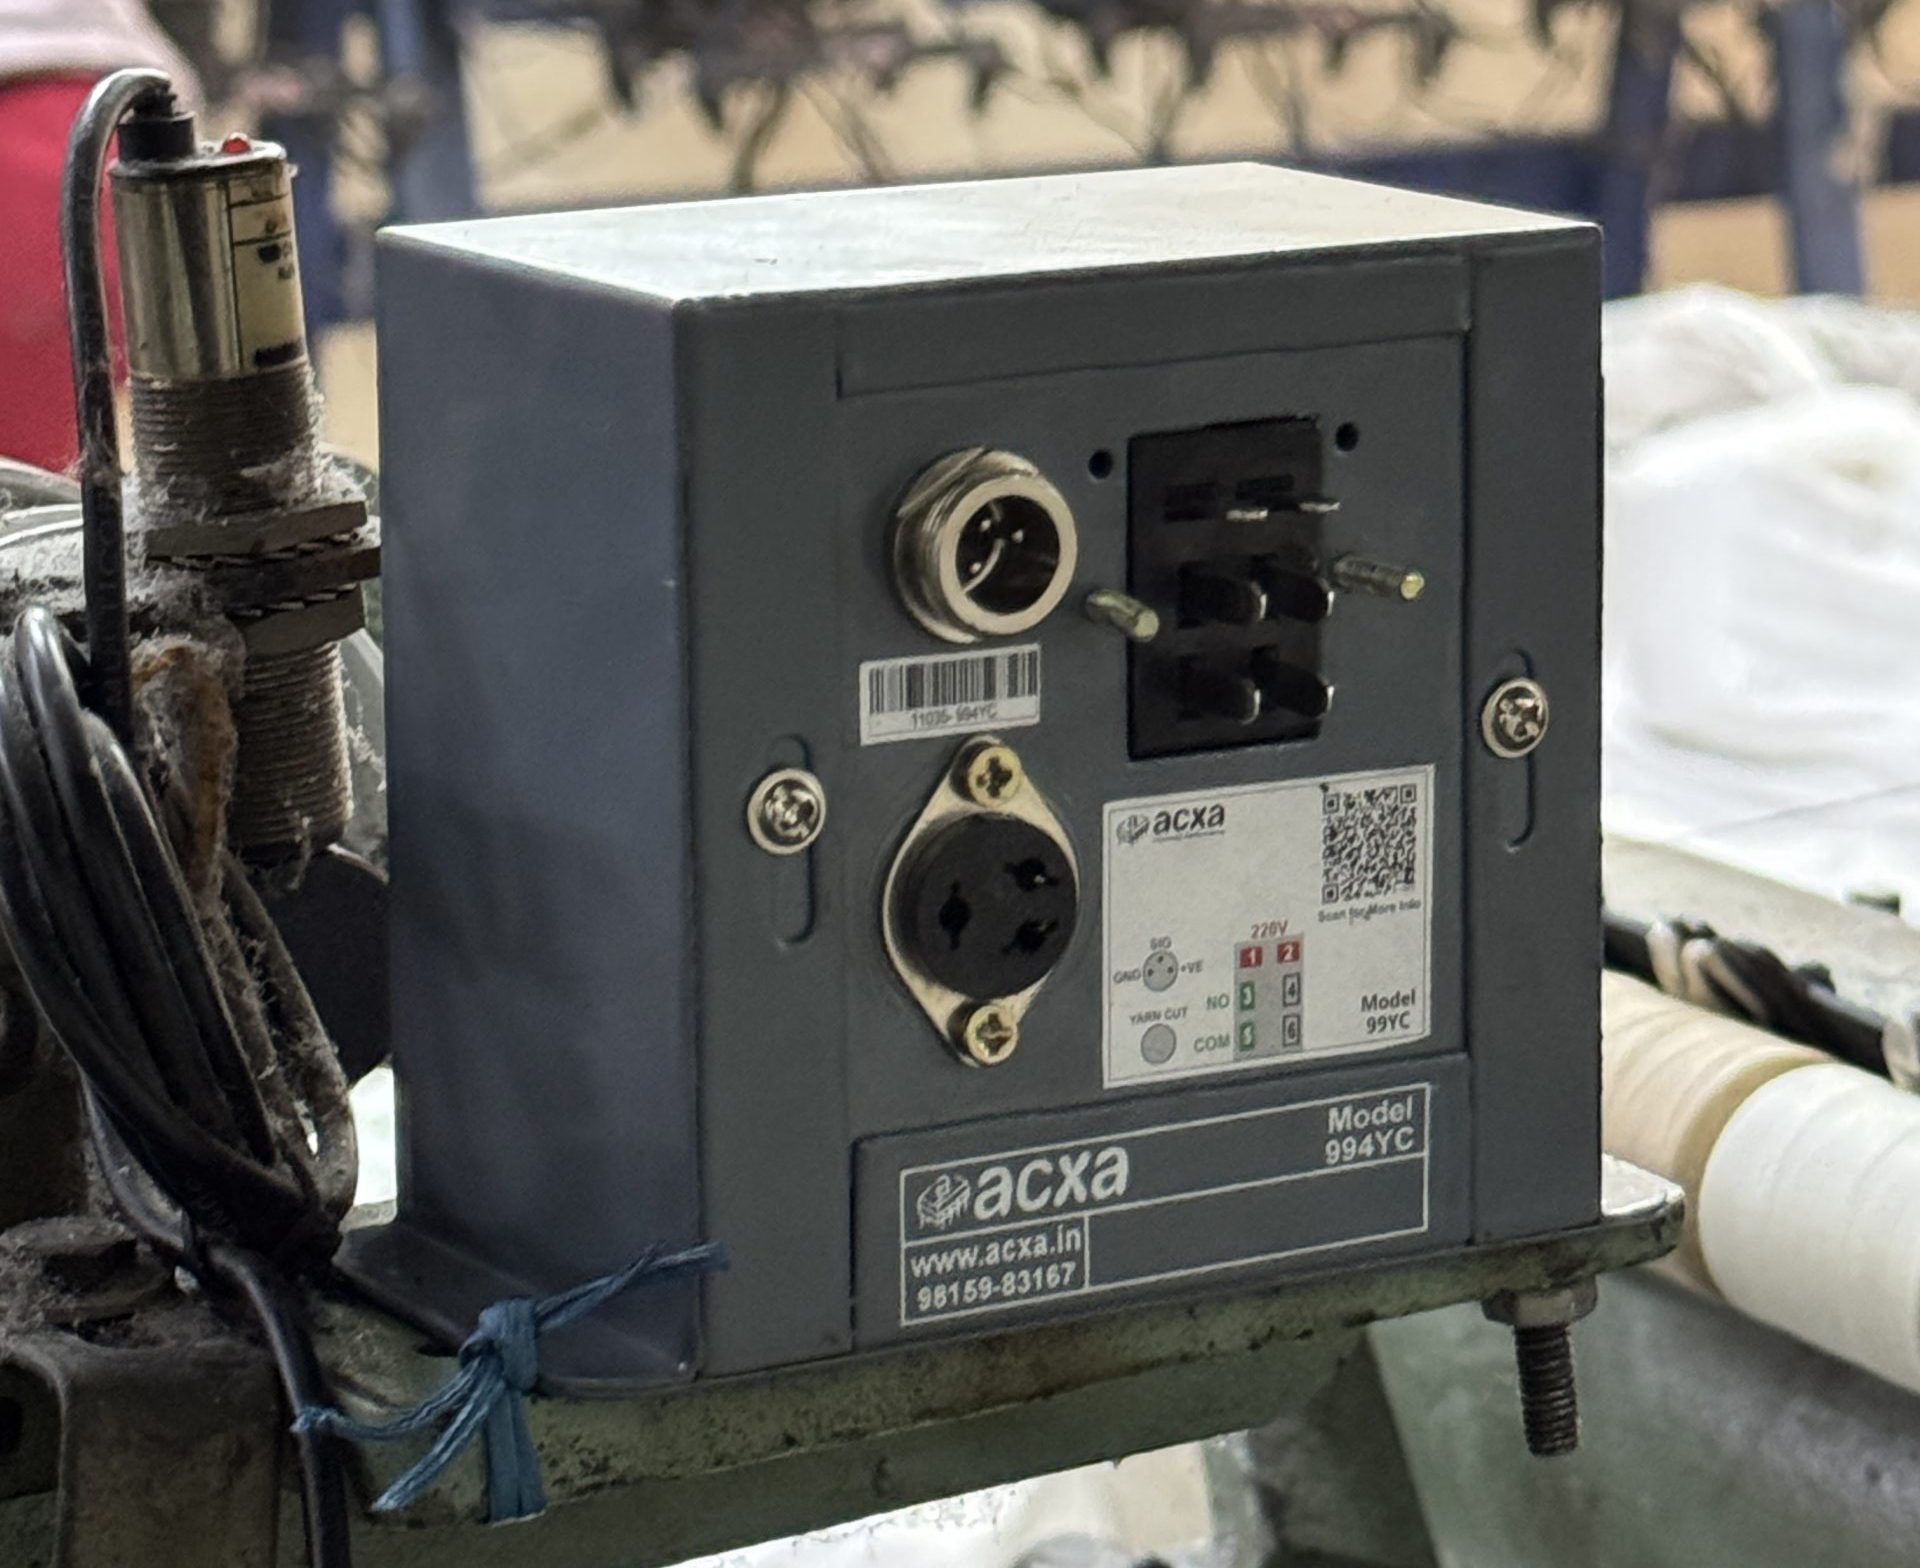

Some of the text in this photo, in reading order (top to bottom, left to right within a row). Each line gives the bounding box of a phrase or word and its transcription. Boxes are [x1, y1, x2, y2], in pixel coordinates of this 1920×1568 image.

[1153, 803, 1225, 835] acxa
[1251, 920, 1288, 939] 220V
[1206, 993, 1230, 1010] NO
[1361, 987, 1416, 1013] Model
[1129, 1006, 1188, 1025] YARN CUT
[1366, 1010, 1410, 1035] 99YC
[1193, 1033, 1231, 1053] COM
[1328, 1095, 1413, 1134] Model
[1325, 1126, 1415, 1166] 994YC
[973, 1146, 1129, 1221] acxa
[910, 1223, 1082, 1279] www.acxa.in
[917, 1261, 1077, 1312] 98159-83167
